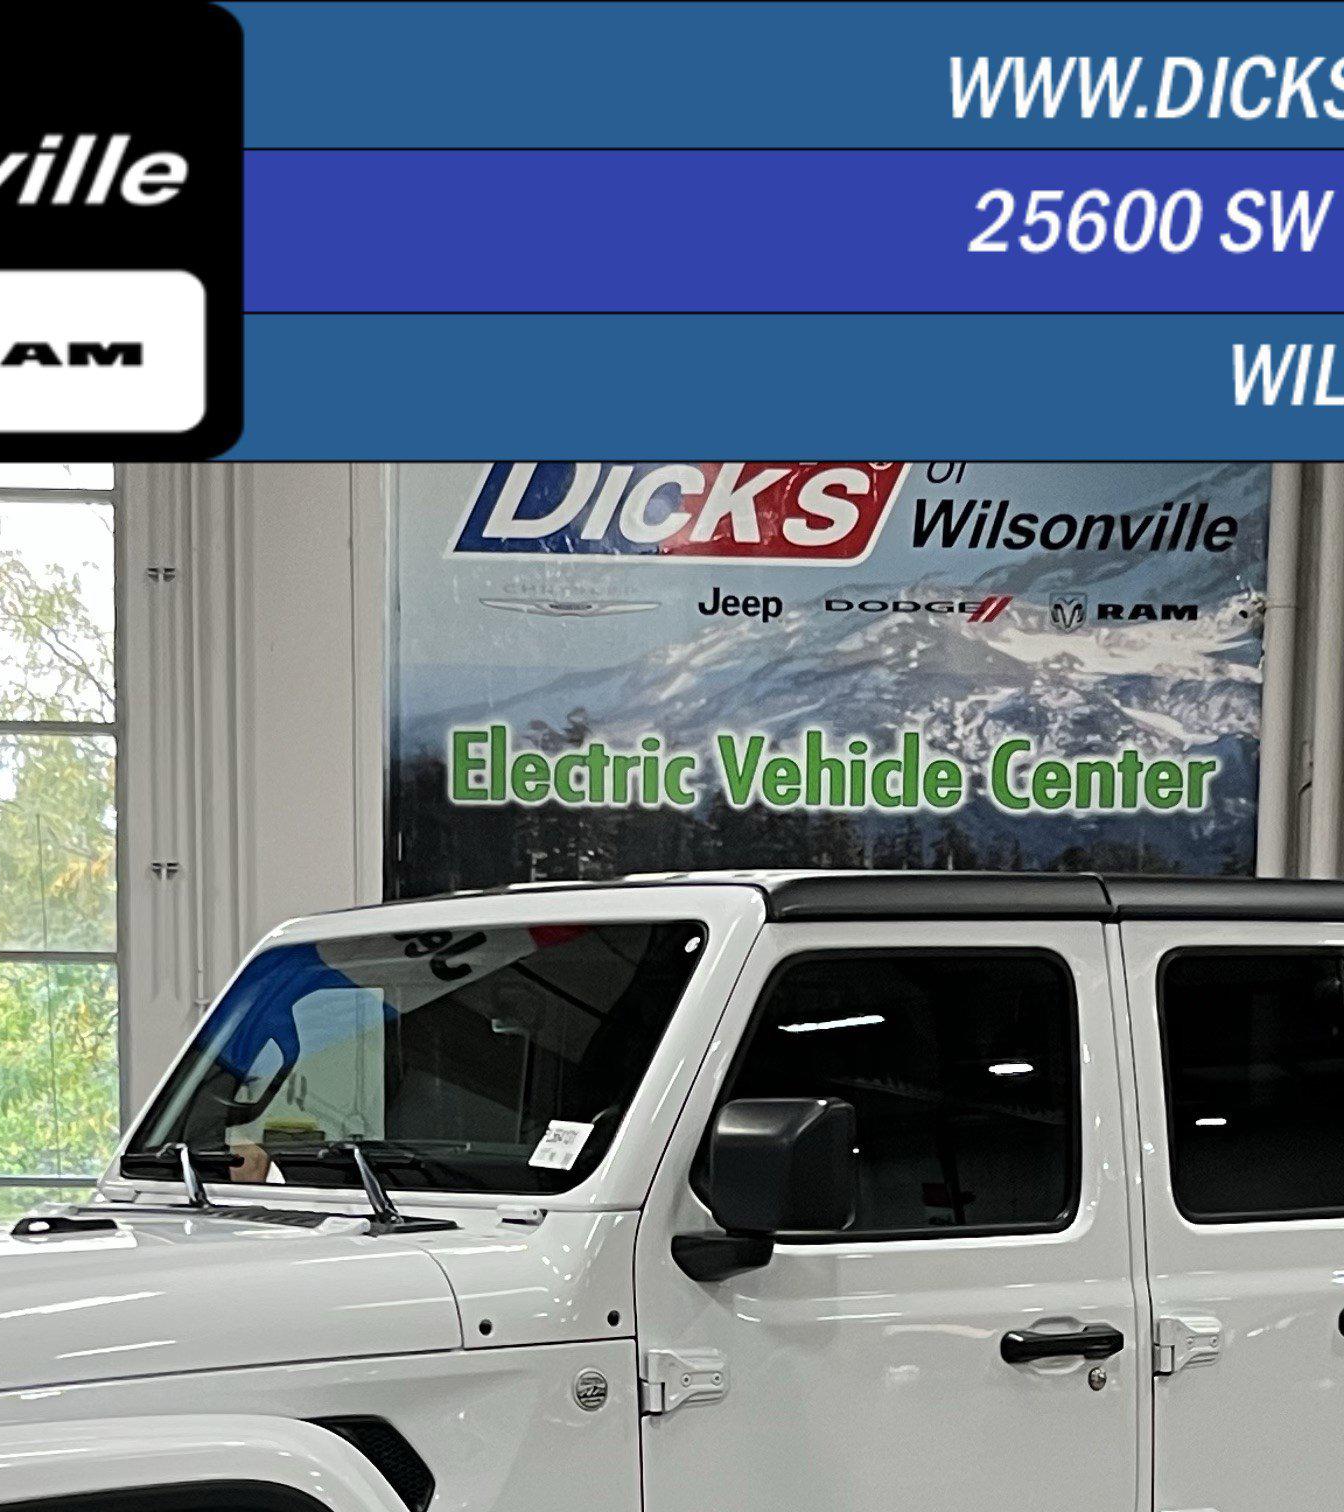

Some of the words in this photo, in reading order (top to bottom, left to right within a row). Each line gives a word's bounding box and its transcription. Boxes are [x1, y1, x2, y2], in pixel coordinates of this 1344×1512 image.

[482, 462, 870, 547] Dicks
[912, 499, 1238, 552] Wilsonville
[698, 587, 783, 622] Jeep
[825, 599, 980, 614] DODGE
[1097, 603, 1199, 621] RAM
[454, 726, 695, 804] Electric
[717, 730, 962, 808] Vehicle
[991, 740, 1217, 809] Center
